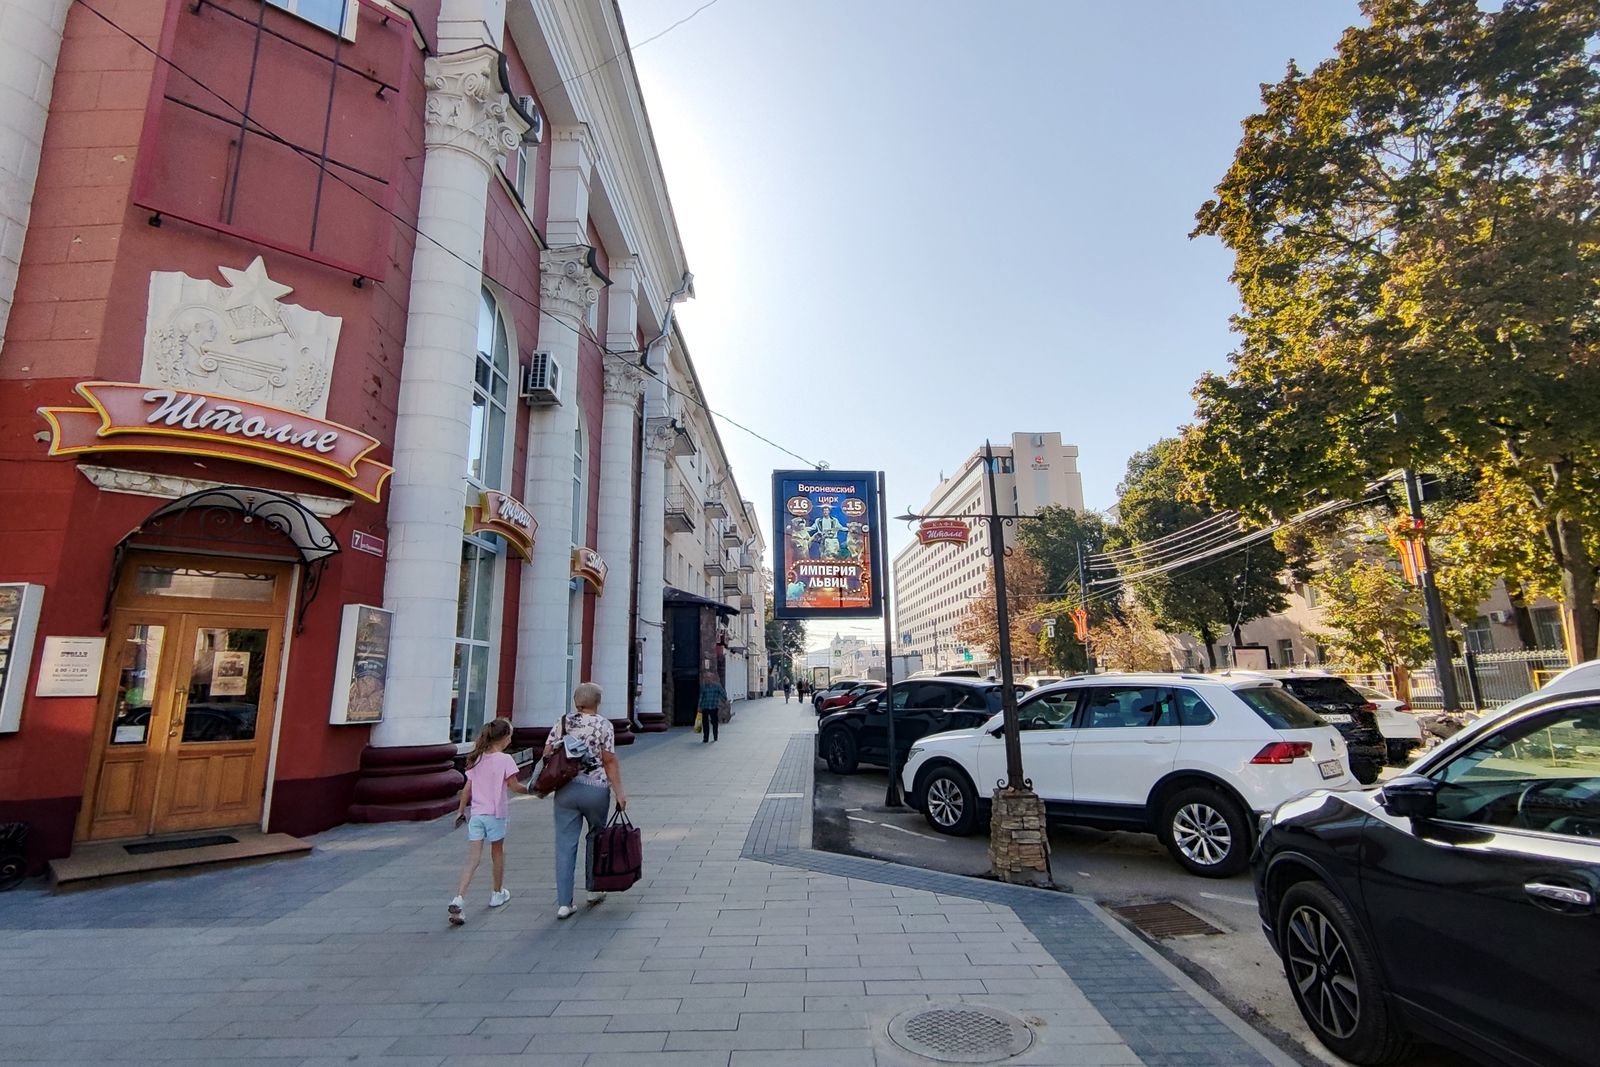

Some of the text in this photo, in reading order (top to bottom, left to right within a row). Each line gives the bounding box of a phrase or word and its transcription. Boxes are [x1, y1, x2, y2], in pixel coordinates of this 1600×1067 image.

[143, 389, 339, 453] Штолле
[798, 483, 856, 494] Воронежский
[354, 534, 361, 546] 7
[926, 530, 963, 539] Штолле
[800, 565, 856, 576] ИМПЕРИЯ
[808, 577, 849, 589] ЛЬВИЦ
